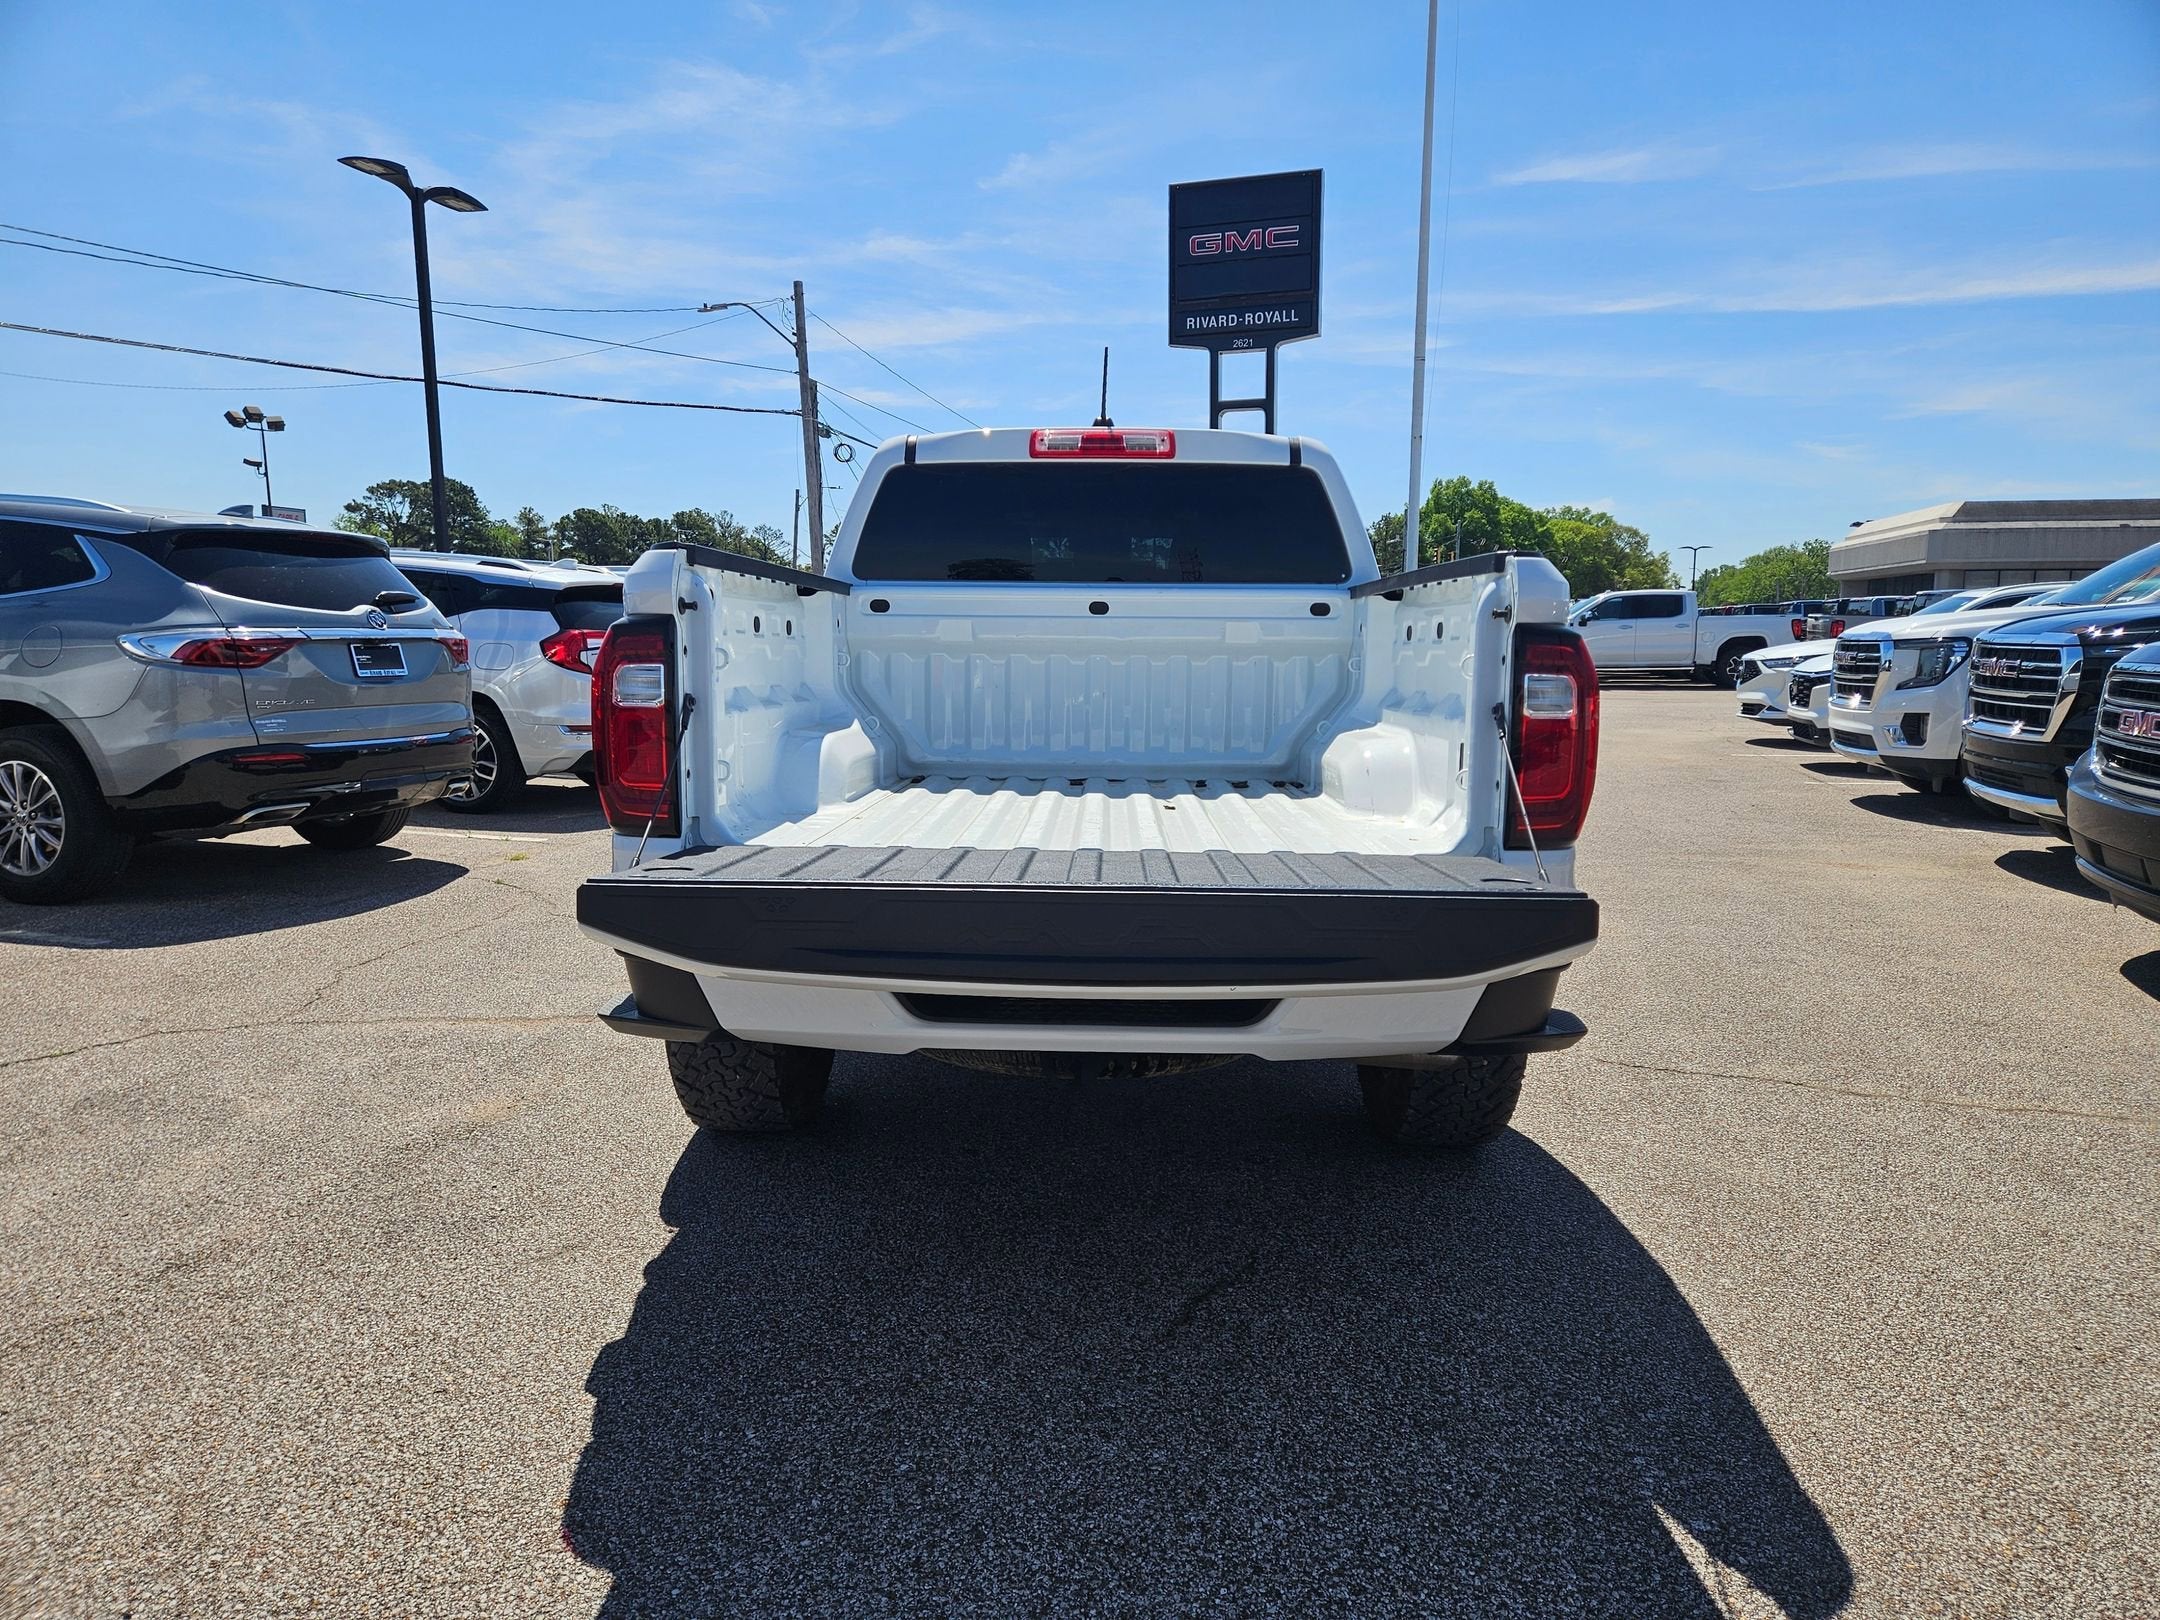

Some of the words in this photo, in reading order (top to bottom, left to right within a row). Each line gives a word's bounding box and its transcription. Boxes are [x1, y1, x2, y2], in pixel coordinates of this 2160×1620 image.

[1189, 225, 1300, 256] GMC
[1186, 309, 1299, 330] RIVARD-ROYALL
[1232, 338, 1254, 348] 2621
[1979, 658, 2020, 678] GMC
